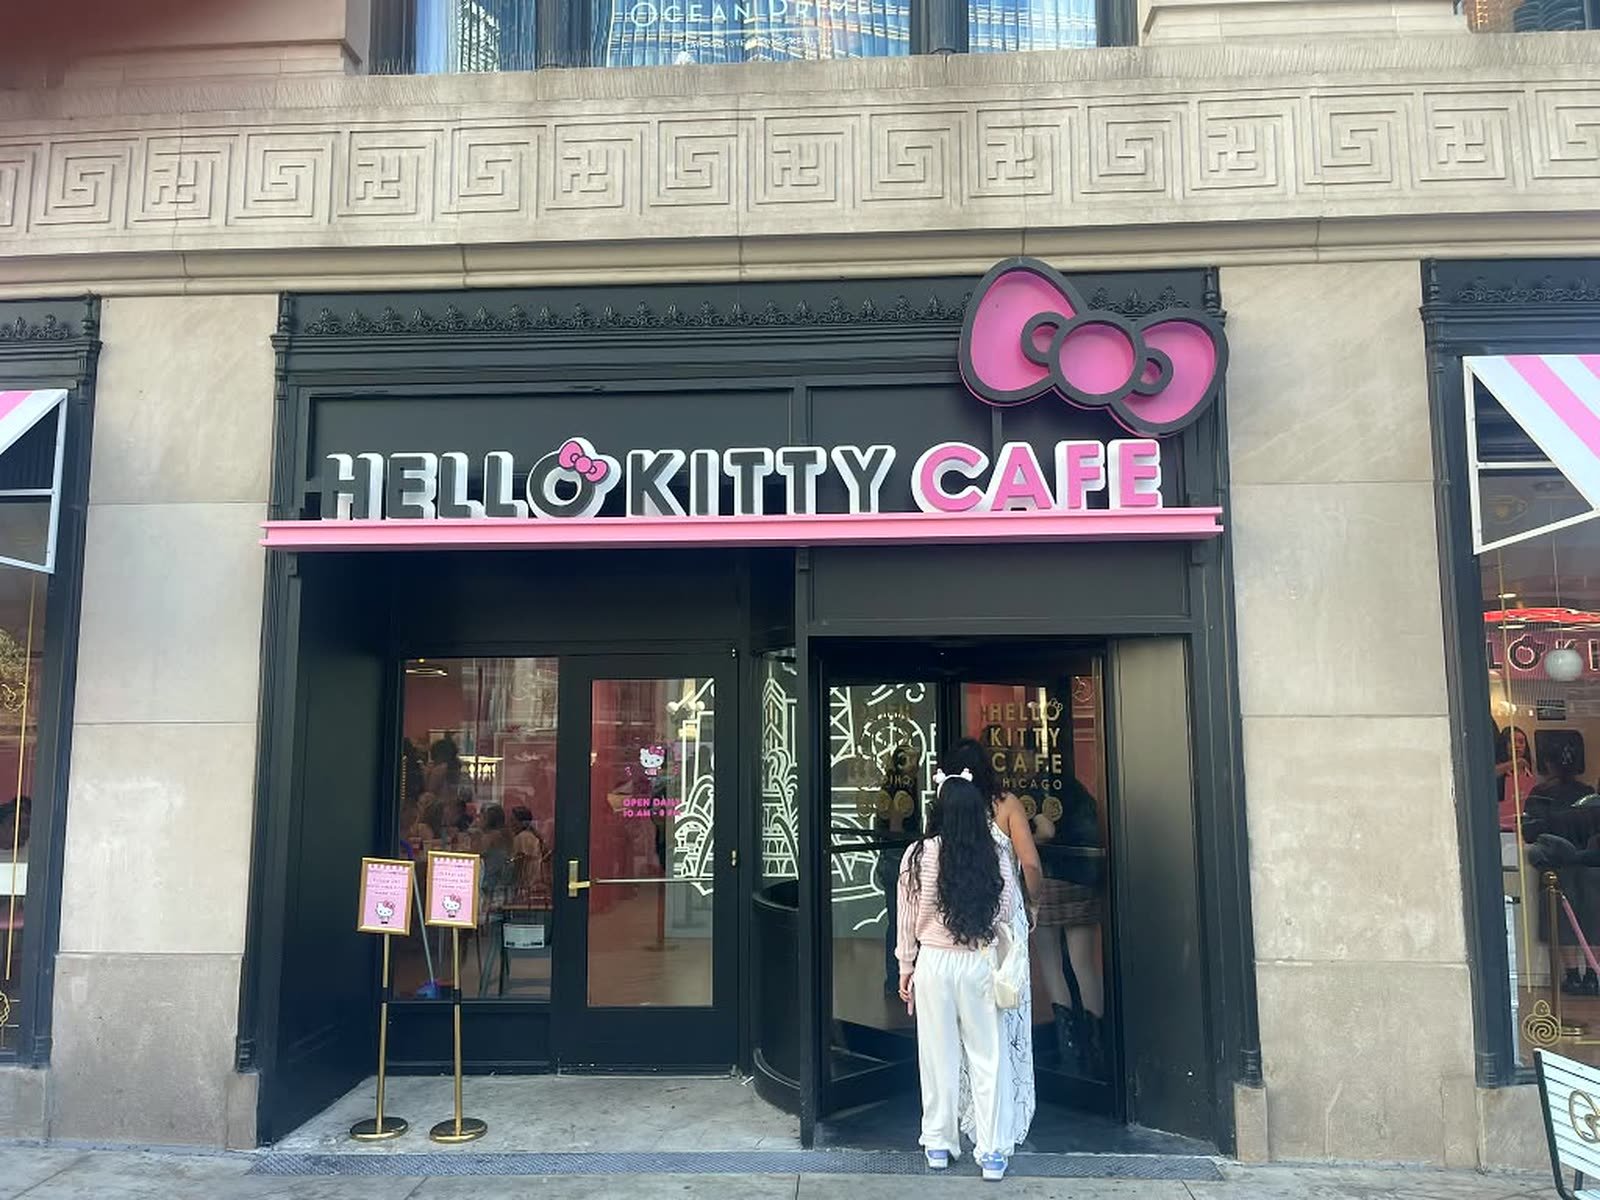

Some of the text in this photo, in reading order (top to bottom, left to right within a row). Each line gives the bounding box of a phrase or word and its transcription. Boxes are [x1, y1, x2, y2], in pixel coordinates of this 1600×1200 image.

[631, 2, 750, 27] OCEAN
[321, 438, 1162, 520] HELLO KITTY CAFE
[991, 698, 1062, 721] HELLO
[990, 727, 1060, 748] KITTY
[991, 752, 1062, 774] CAFE
[1002, 778, 1062, 790] HICAGO
[623, 798, 650, 807] OPEN
[623, 809, 634, 817] 10
[637, 809, 650, 817] AM
